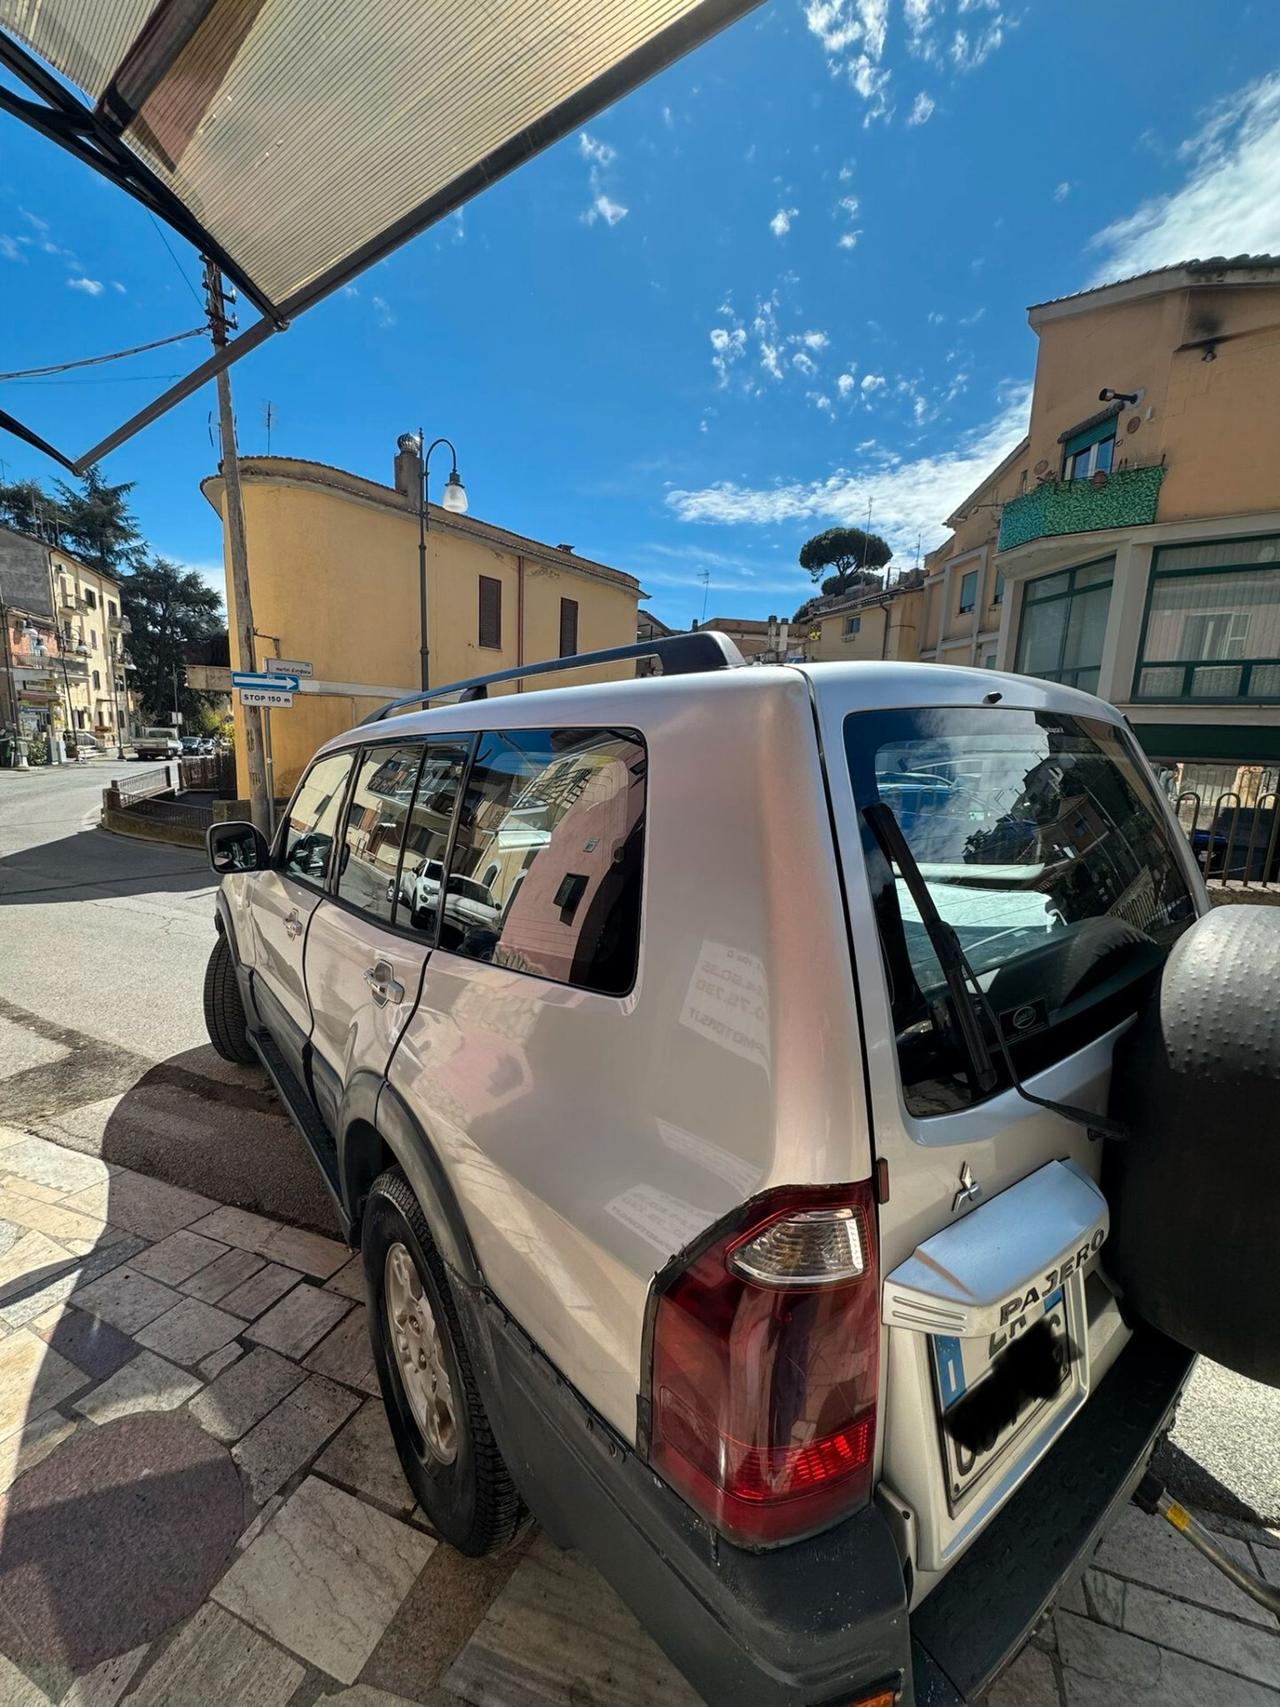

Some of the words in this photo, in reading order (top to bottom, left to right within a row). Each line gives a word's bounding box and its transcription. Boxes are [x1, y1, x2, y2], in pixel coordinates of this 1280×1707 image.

[244, 694, 265, 702] STOP
[268, 695, 281, 703] 150
[1000, 1229, 1104, 1327] PAJERO
[948, 1360, 956, 1392] I
